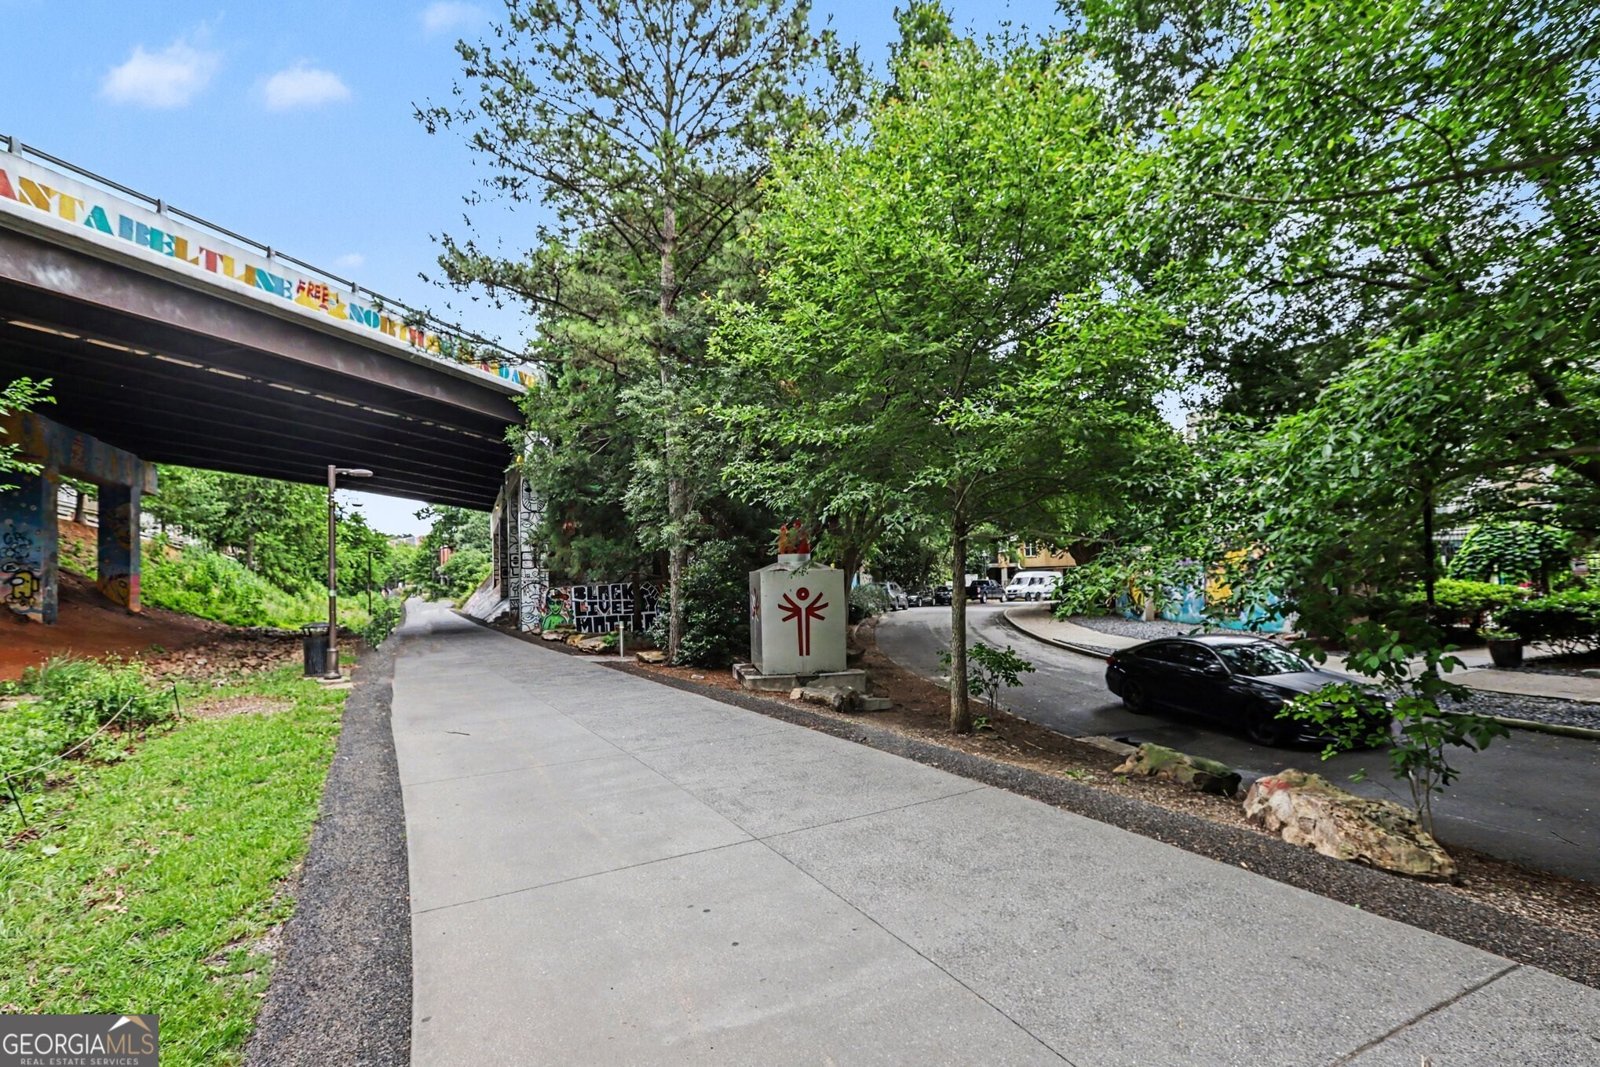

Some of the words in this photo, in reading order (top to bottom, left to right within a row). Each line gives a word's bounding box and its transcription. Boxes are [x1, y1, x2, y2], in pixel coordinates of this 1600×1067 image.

[119, 214, 293, 300] BELTLINE
[297, 280, 329, 304] FREE
[572, 583, 634, 601] BLACK
